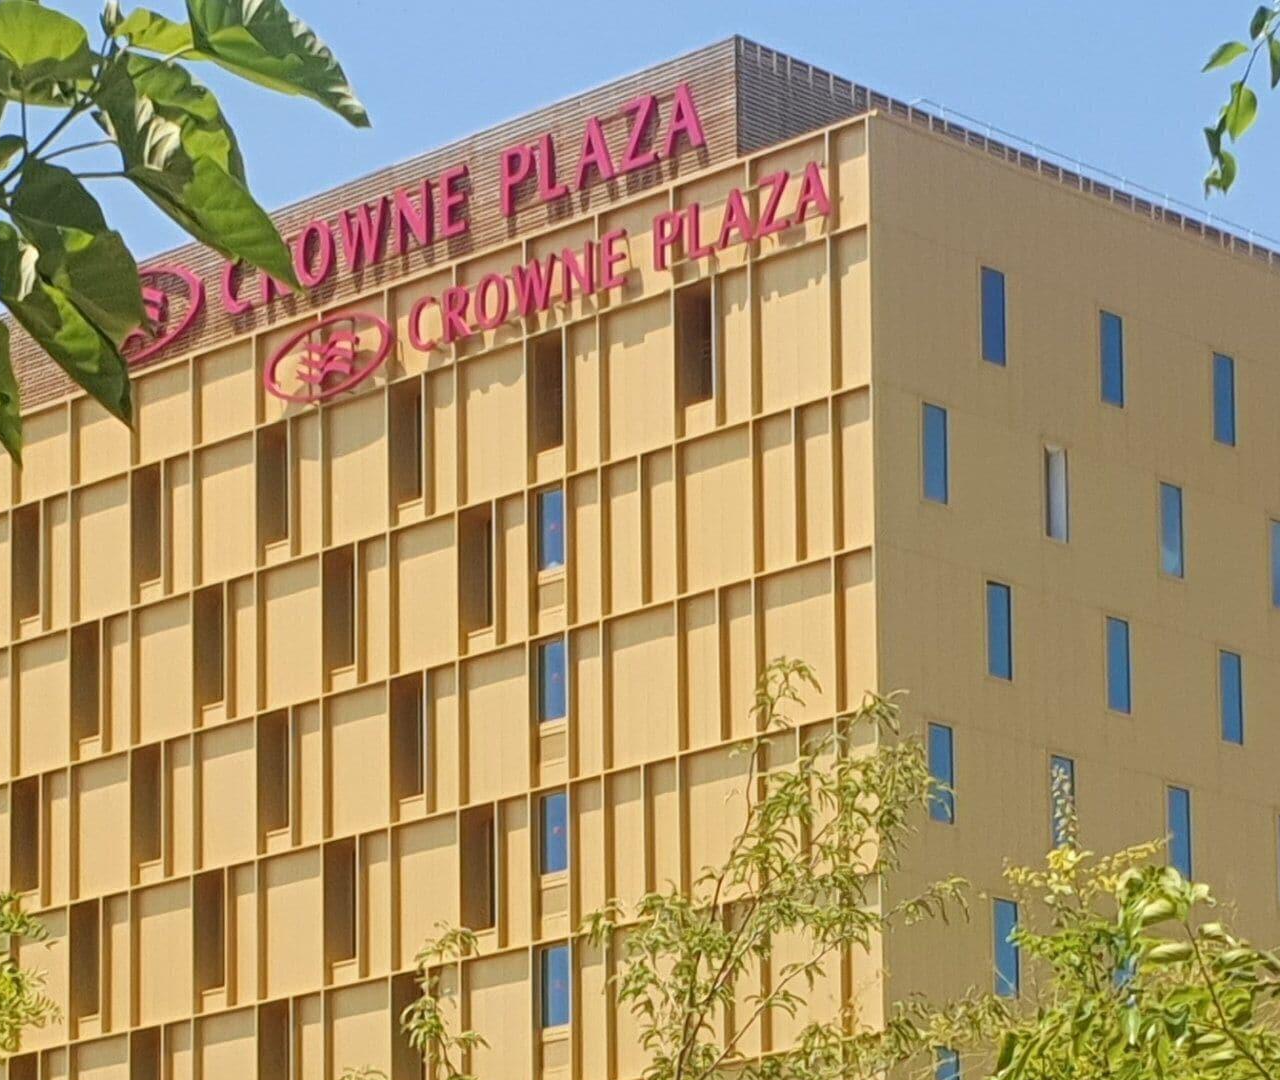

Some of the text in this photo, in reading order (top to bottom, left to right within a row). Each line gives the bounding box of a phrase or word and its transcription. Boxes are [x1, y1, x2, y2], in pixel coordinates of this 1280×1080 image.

[500, 81, 705, 217] PLAZA
[407, 161, 831, 352] CROWNE PLAZA
